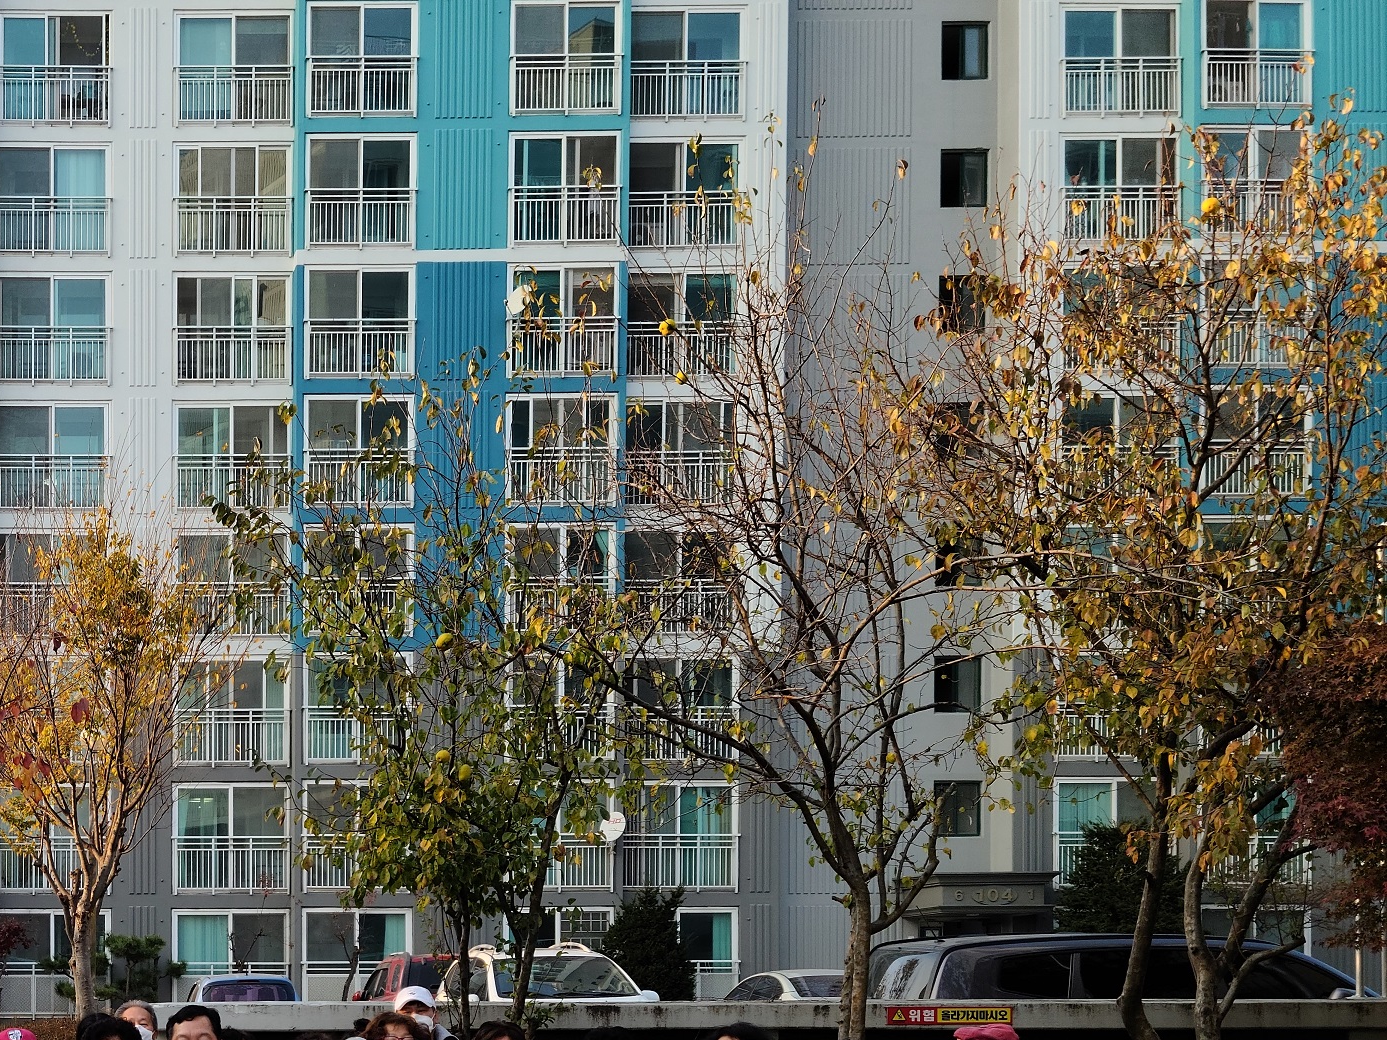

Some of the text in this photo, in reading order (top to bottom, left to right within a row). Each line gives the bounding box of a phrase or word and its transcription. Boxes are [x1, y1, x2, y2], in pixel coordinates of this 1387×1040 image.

[954, 889, 964, 902] 6
[976, 887, 1014, 903] 104
[908, 1009, 1008, 1022] 위험 올라가지마시오
